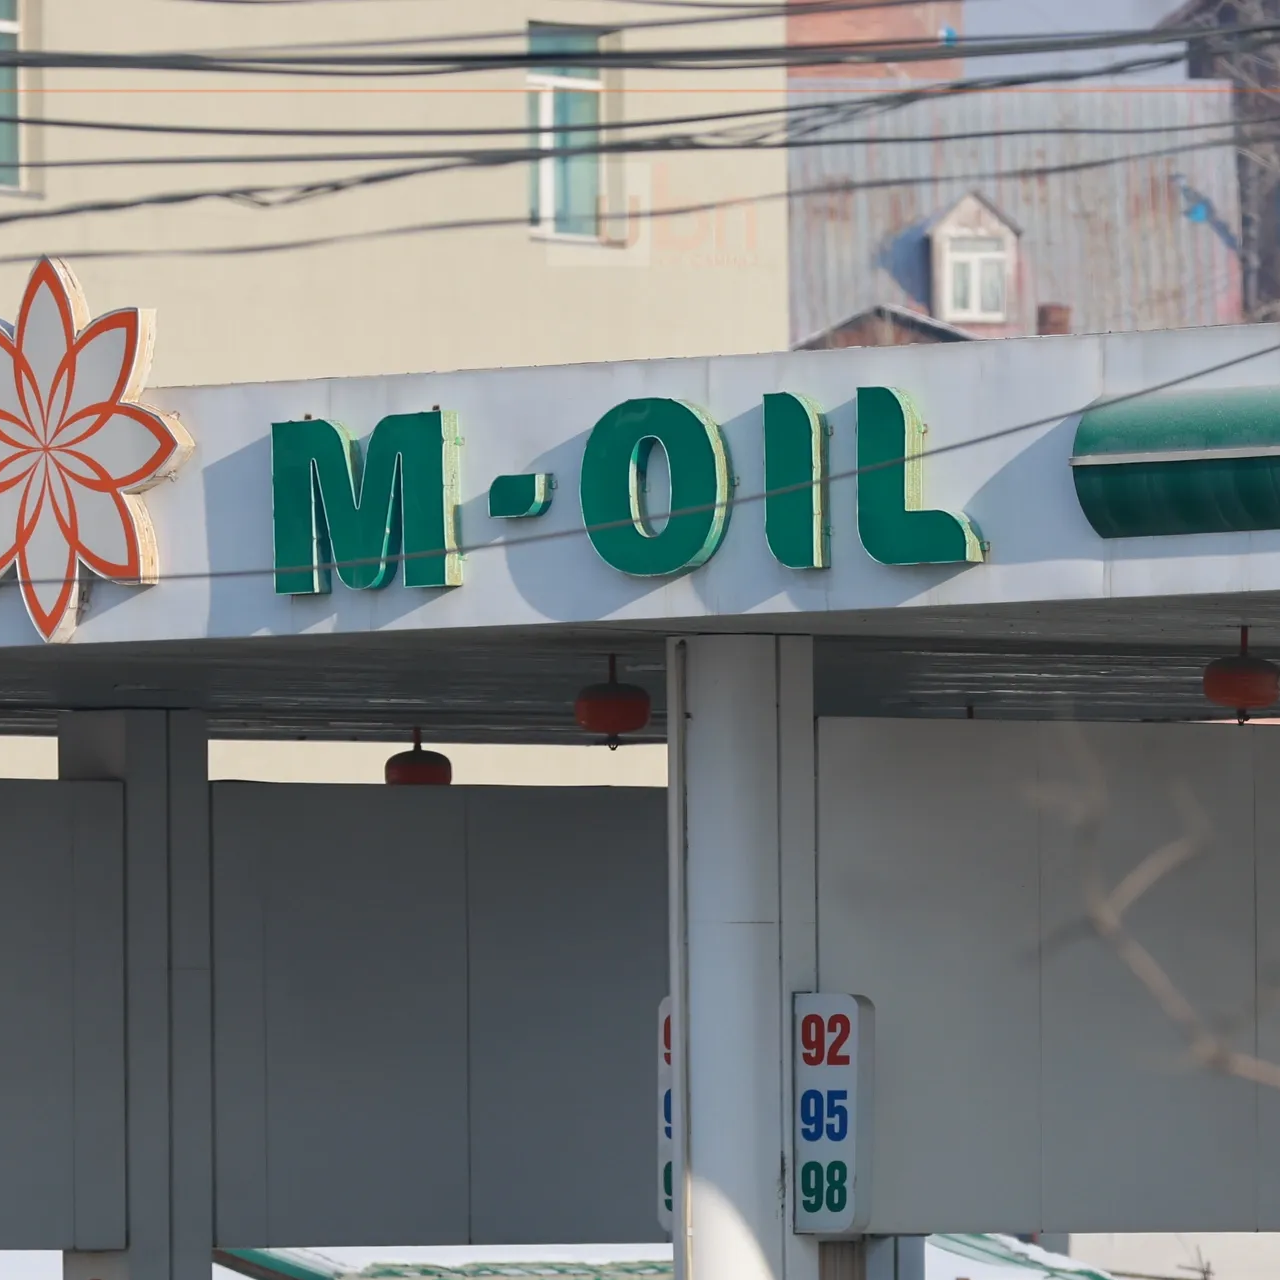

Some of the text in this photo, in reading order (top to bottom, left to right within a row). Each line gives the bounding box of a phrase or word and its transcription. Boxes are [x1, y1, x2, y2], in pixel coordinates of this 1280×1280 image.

[271, 386, 988, 597] M-OIL
[802, 1014, 851, 1066] 92
[801, 1089, 849, 1142] 95
[801, 1160, 848, 1213] 98
